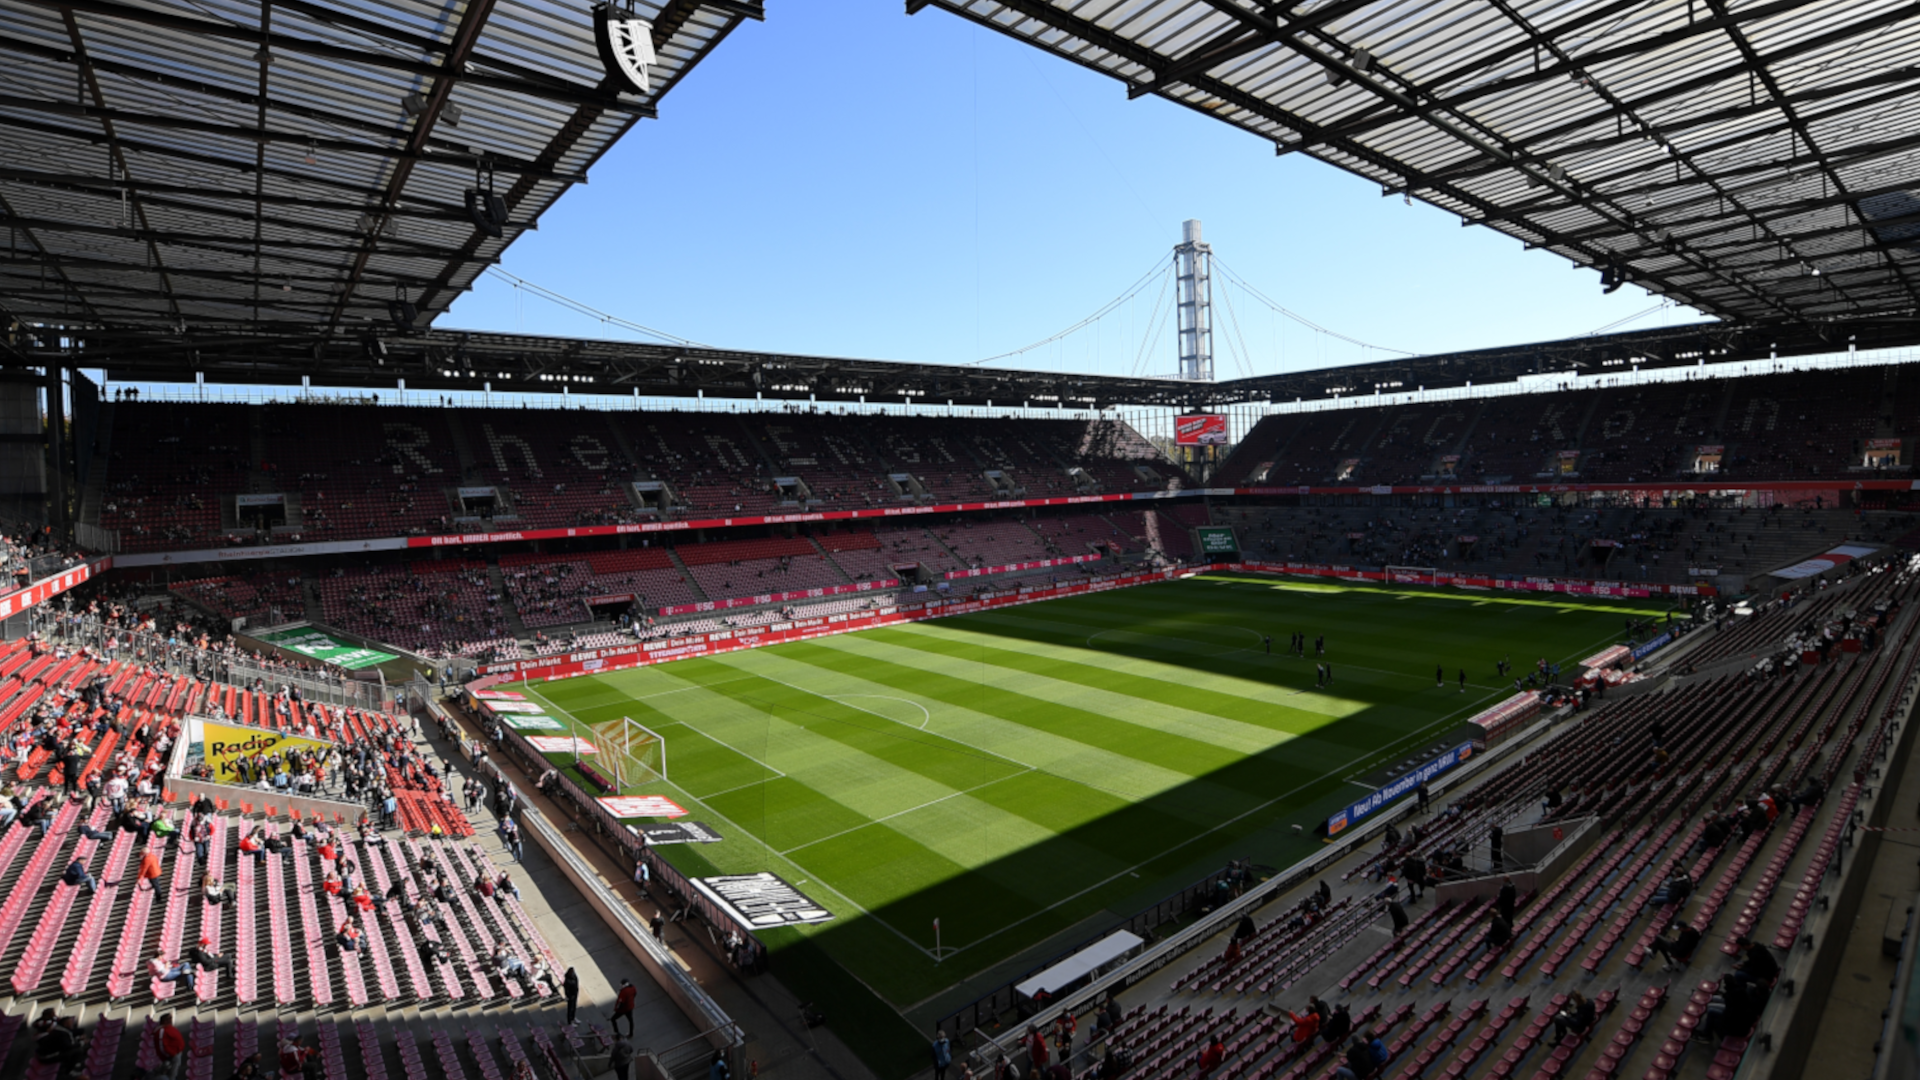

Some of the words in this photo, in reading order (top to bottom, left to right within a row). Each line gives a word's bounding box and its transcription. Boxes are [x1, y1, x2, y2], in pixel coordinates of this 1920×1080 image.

[1669, 585, 1698, 594] REWE
[323, 648, 376, 664] DEVK
[520, 661, 537, 670] Dein
[538, 657, 562, 667] Markt
[570, 651, 598, 662] REWE
[600, 648, 616, 657] Dein
[617, 646, 637, 655] Markt
[643, 640, 667, 651] REWE
[671, 639, 685, 647] Dein
[685, 636, 705, 645] Markt
[709, 632, 732, 641] REWE
[734, 630, 746, 638] Dein
[747, 627, 765, 635] Markt
[771, 622, 793, 632] REWE
[212, 734, 277, 756] Radio
[1353, 797, 1371, 818] Neu!
[1371, 791, 1383, 807] Ab
[1382, 773, 1415, 802] November
[1422, 762, 1438, 782] ganz
